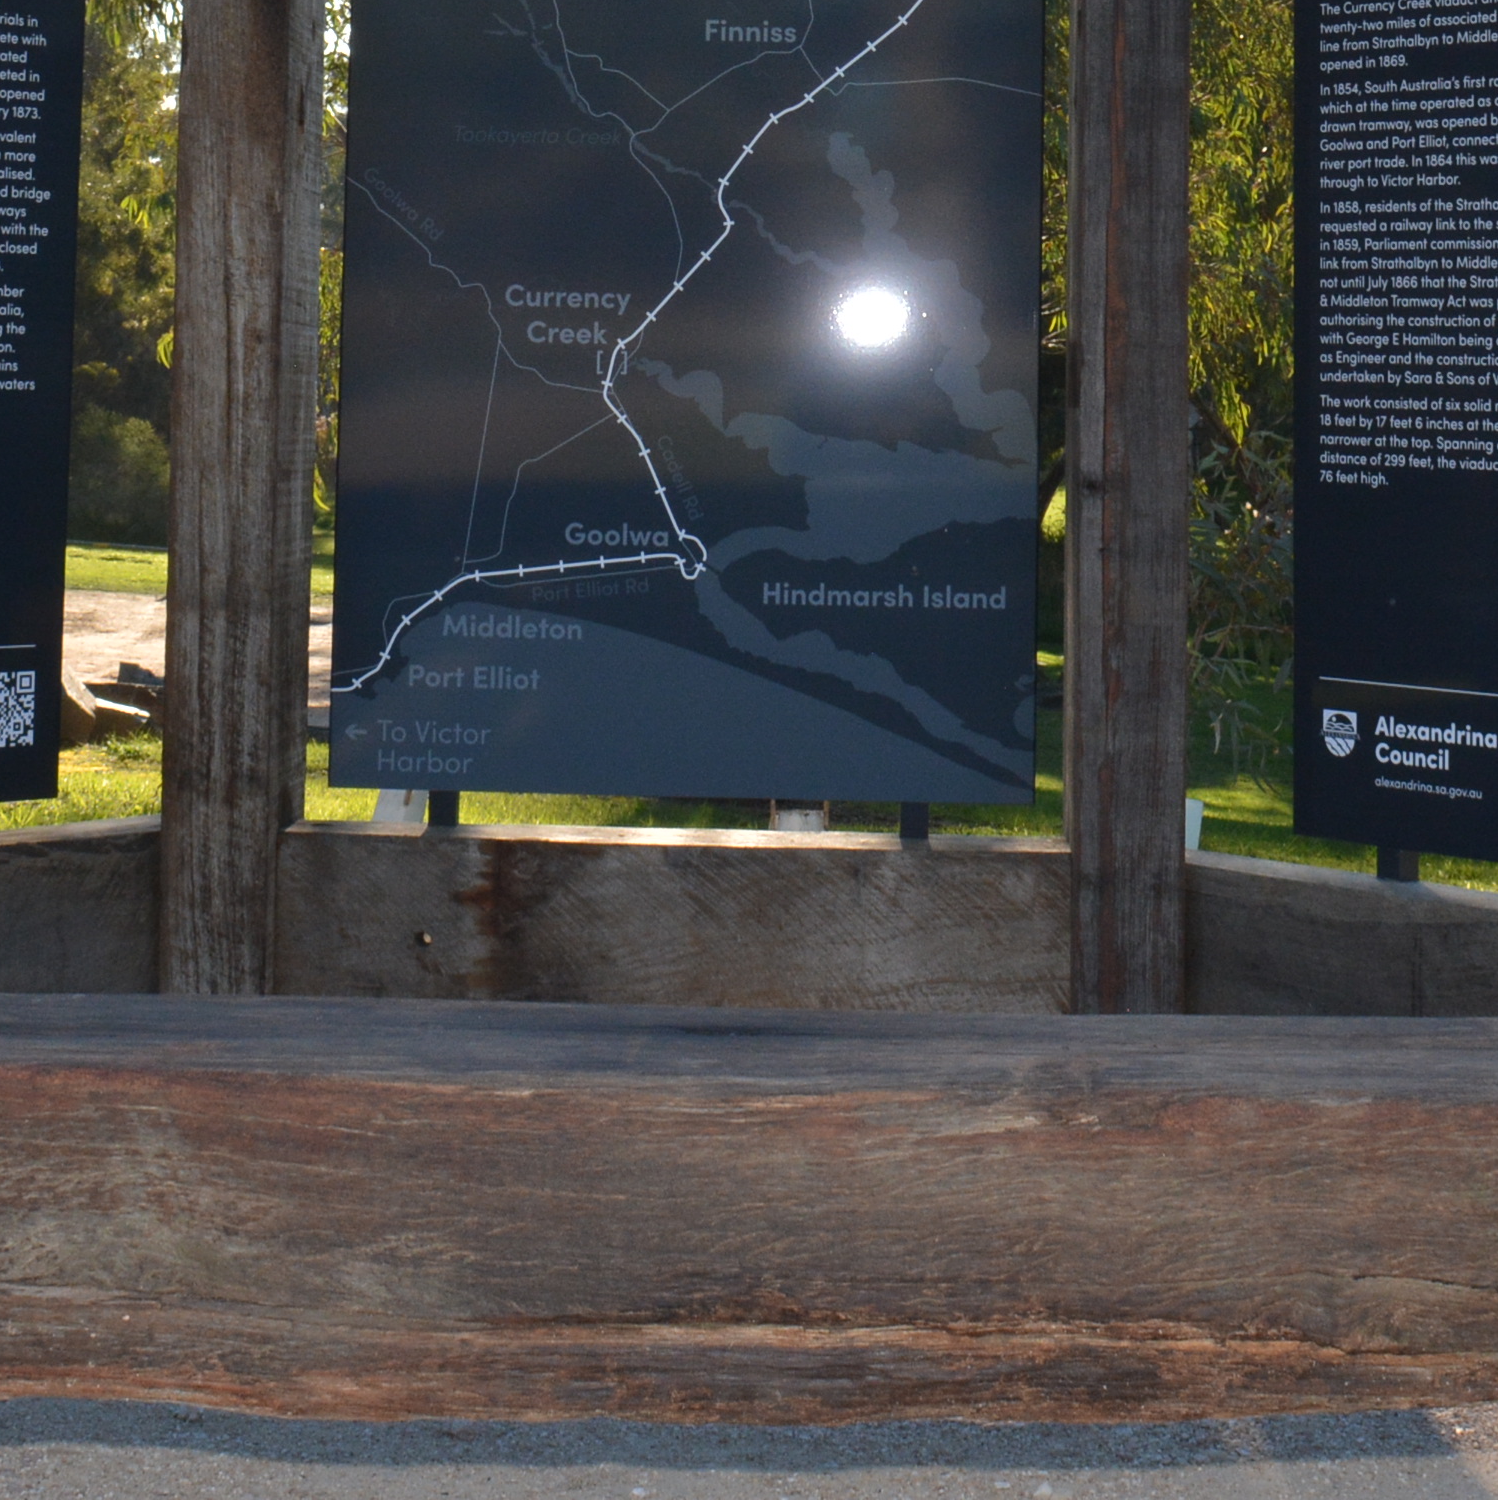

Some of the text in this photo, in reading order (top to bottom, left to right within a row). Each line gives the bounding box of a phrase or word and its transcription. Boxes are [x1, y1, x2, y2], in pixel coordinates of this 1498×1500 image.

[1320, 2, 1341, 15] The
[1343, 0, 1395, 14] Currency
[705, 19, 797, 42] Finniss
[1320, 19, 1383, 35] twenty-two
[1387, 15, 1416, 29] miles
[1419, 13, 1431, 27] of
[1433, 8, 1497, 26] associated
[1320, 53, 1408, 74] opened in 1869.
[11, 185, 51, 203] bridge
[1320, 171, 1461, 192] through to Victor Harbor.
[364, 167, 444, 241] Goolwa Rd
[1, 221, 26, 235] with
[29, 222, 49, 237] the
[1320, 238, 1330, 251] in
[1333, 237, 1361, 252] 1859,
[1365, 237, 1427, 250] Parliament
[505, 284, 631, 315] Currency
[527, 321, 608, 344] Creek
[658, 435, 705, 522] Cadell Rd
[1320, 469, 1388, 489] 76 feet high.
[565, 522, 669, 547] Goolwa
[532, 578, 649, 601] Port Elliot Rd
[763, 582, 1007, 610] Hindmarsh Island
[442, 614, 583, 641] Middleton
[409, 664, 541, 690] Port Elliot
[377, 719, 492, 745] To Victor
[1374, 715, 1498, 749] Alexandrina
[377, 749, 474, 774] Harbor
[1375, 742, 1450, 771] Council
[1374, 776, 1483, 800] alexandrina.sa.gov.au
